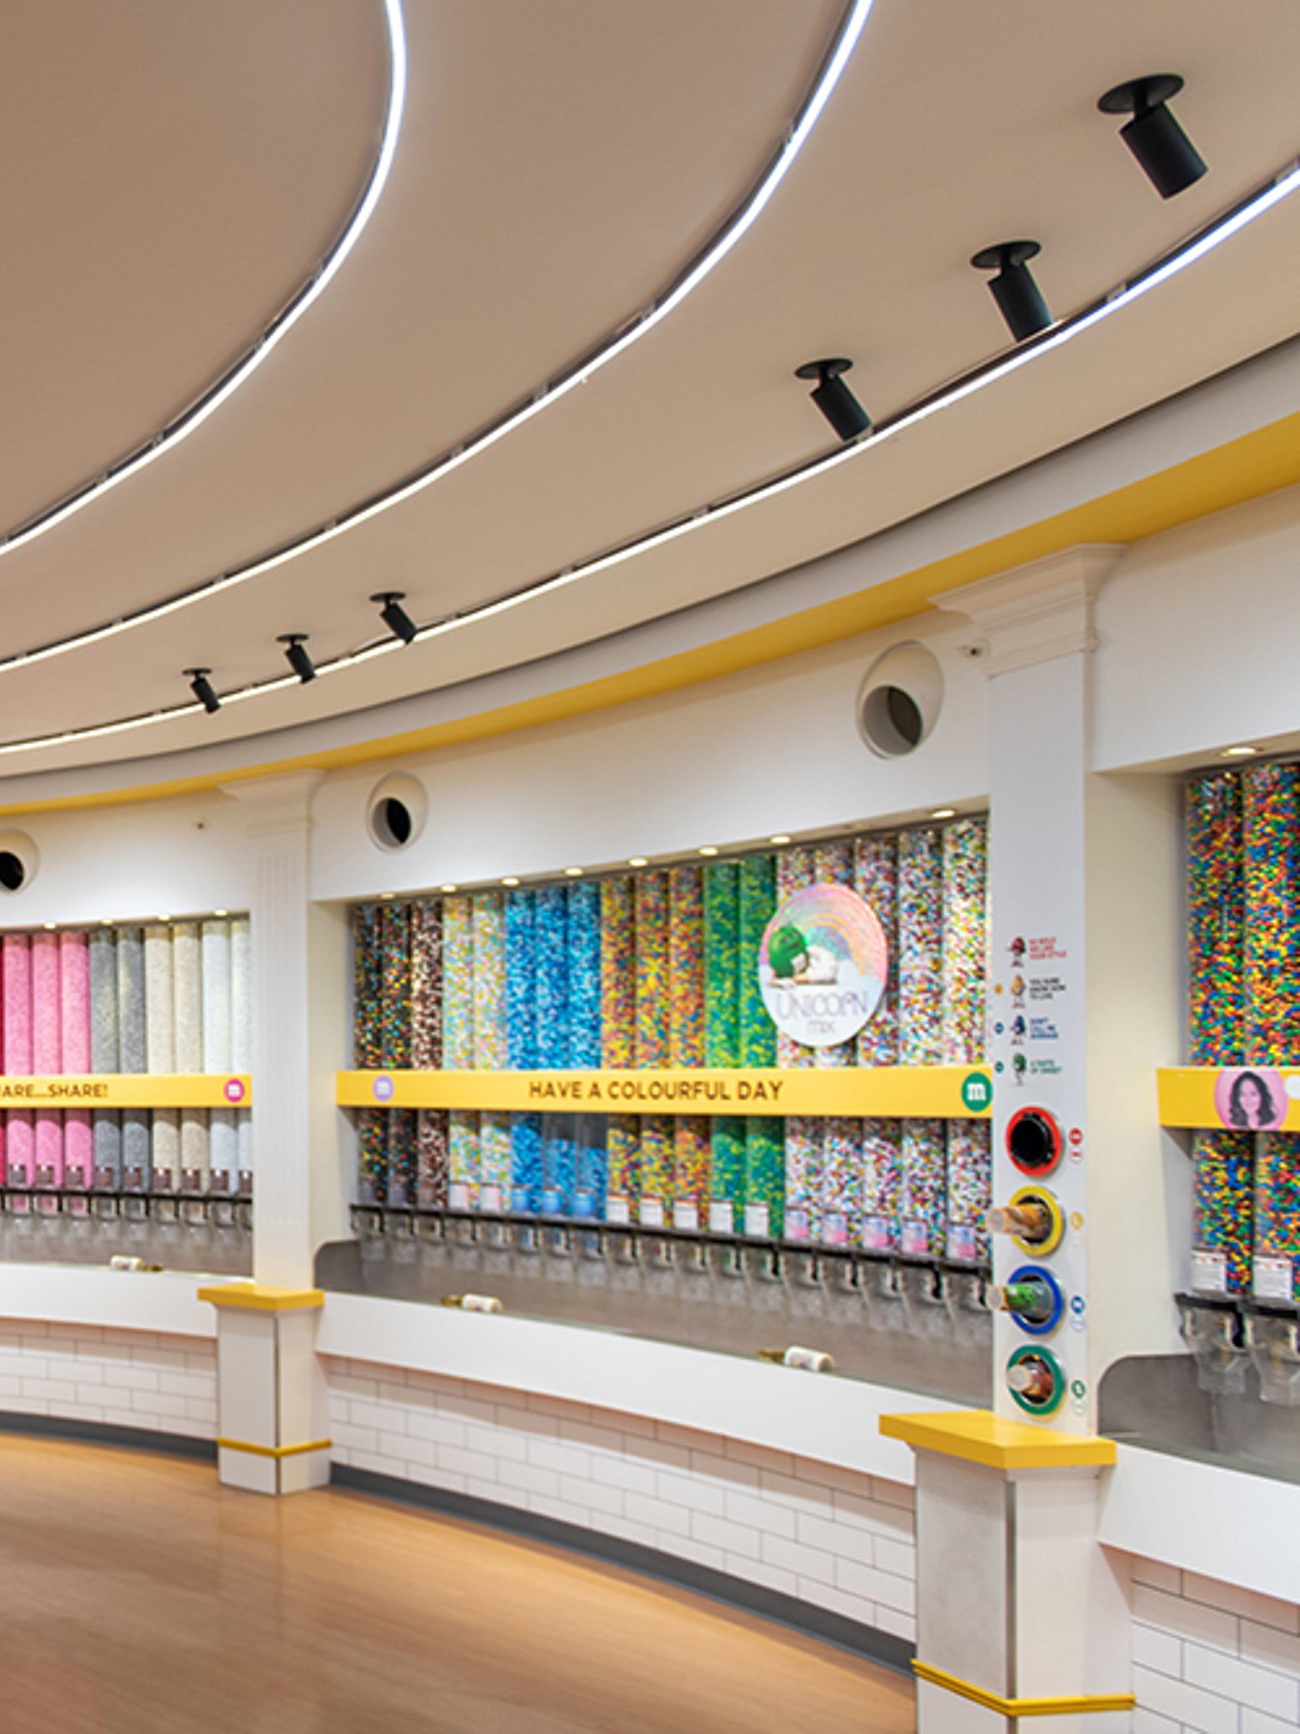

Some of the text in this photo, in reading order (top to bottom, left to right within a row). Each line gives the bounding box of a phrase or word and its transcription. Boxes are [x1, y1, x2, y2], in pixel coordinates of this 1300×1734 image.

[529, 1080, 784, 1101] HAVE A COLOURFUL DAY
